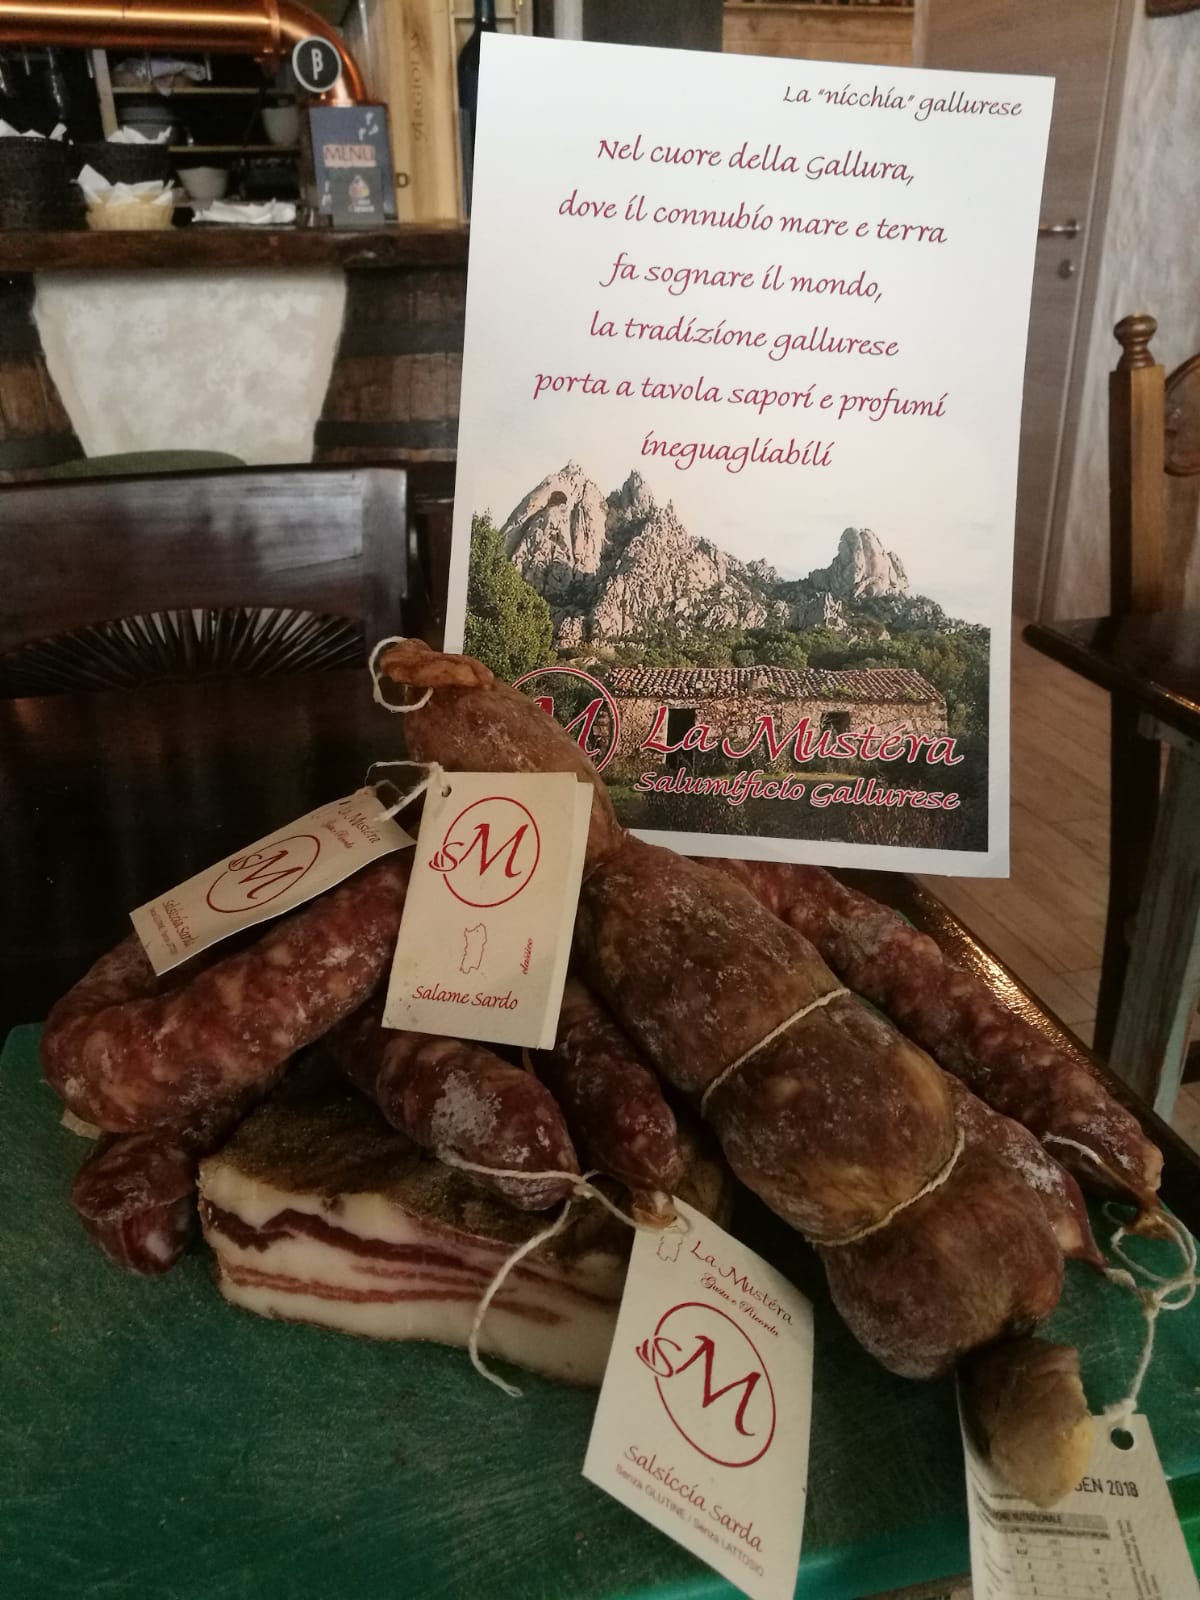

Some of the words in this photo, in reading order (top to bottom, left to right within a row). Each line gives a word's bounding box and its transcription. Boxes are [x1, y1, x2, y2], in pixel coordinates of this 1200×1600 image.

[782, 84, 812, 104] La
[914, 93, 1023, 121] gallurese
[325, 145, 376, 162] MENU
[597, 134, 645, 162] Nel
[650, 146, 722, 168] cuore
[727, 141, 800, 173] della
[805, 150, 916, 186] Gallura,
[558, 188, 618, 219] dove
[623, 194, 649, 221] il
[652, 201, 773, 233] connubio
[778, 213, 849, 237] mare
[854, 219, 870, 238] e
[875, 218, 949, 245] terra
[598, 251, 640, 289] fa
[644, 263, 755, 297] sognare
[760, 262, 785, 291] il
[789, 270, 884, 303] mondo,
[589, 311, 619, 339] la
[623, 315, 768, 348] tradizione
[768, 326, 901, 361] gallurese
[532, 371, 610, 401] porta
[615, 379, 636, 398] a
[640, 374, 721, 404] tavola
[726, 381, 815, 416] sapori
[819, 391, 834, 411] e
[838, 387, 948, 422] profumi
[640, 429, 834, 473] ineguagliabili
[639, 705, 718, 754] La
[722, 714, 966, 766] Mustéra
[633, 764, 805, 808] Salumificio
[809, 777, 962, 811] Gallurese
[411, 982, 470, 1005] Salame
[470, 989, 519, 1011] Sardo
[689, 1239, 718, 1269] La
[719, 1266, 793, 1327] Mustéra
[623, 1444, 707, 1513] Salsiccia
[708, 1502, 764, 1554] Sarda
[1106, 1479, 1140, 1498] 2018
